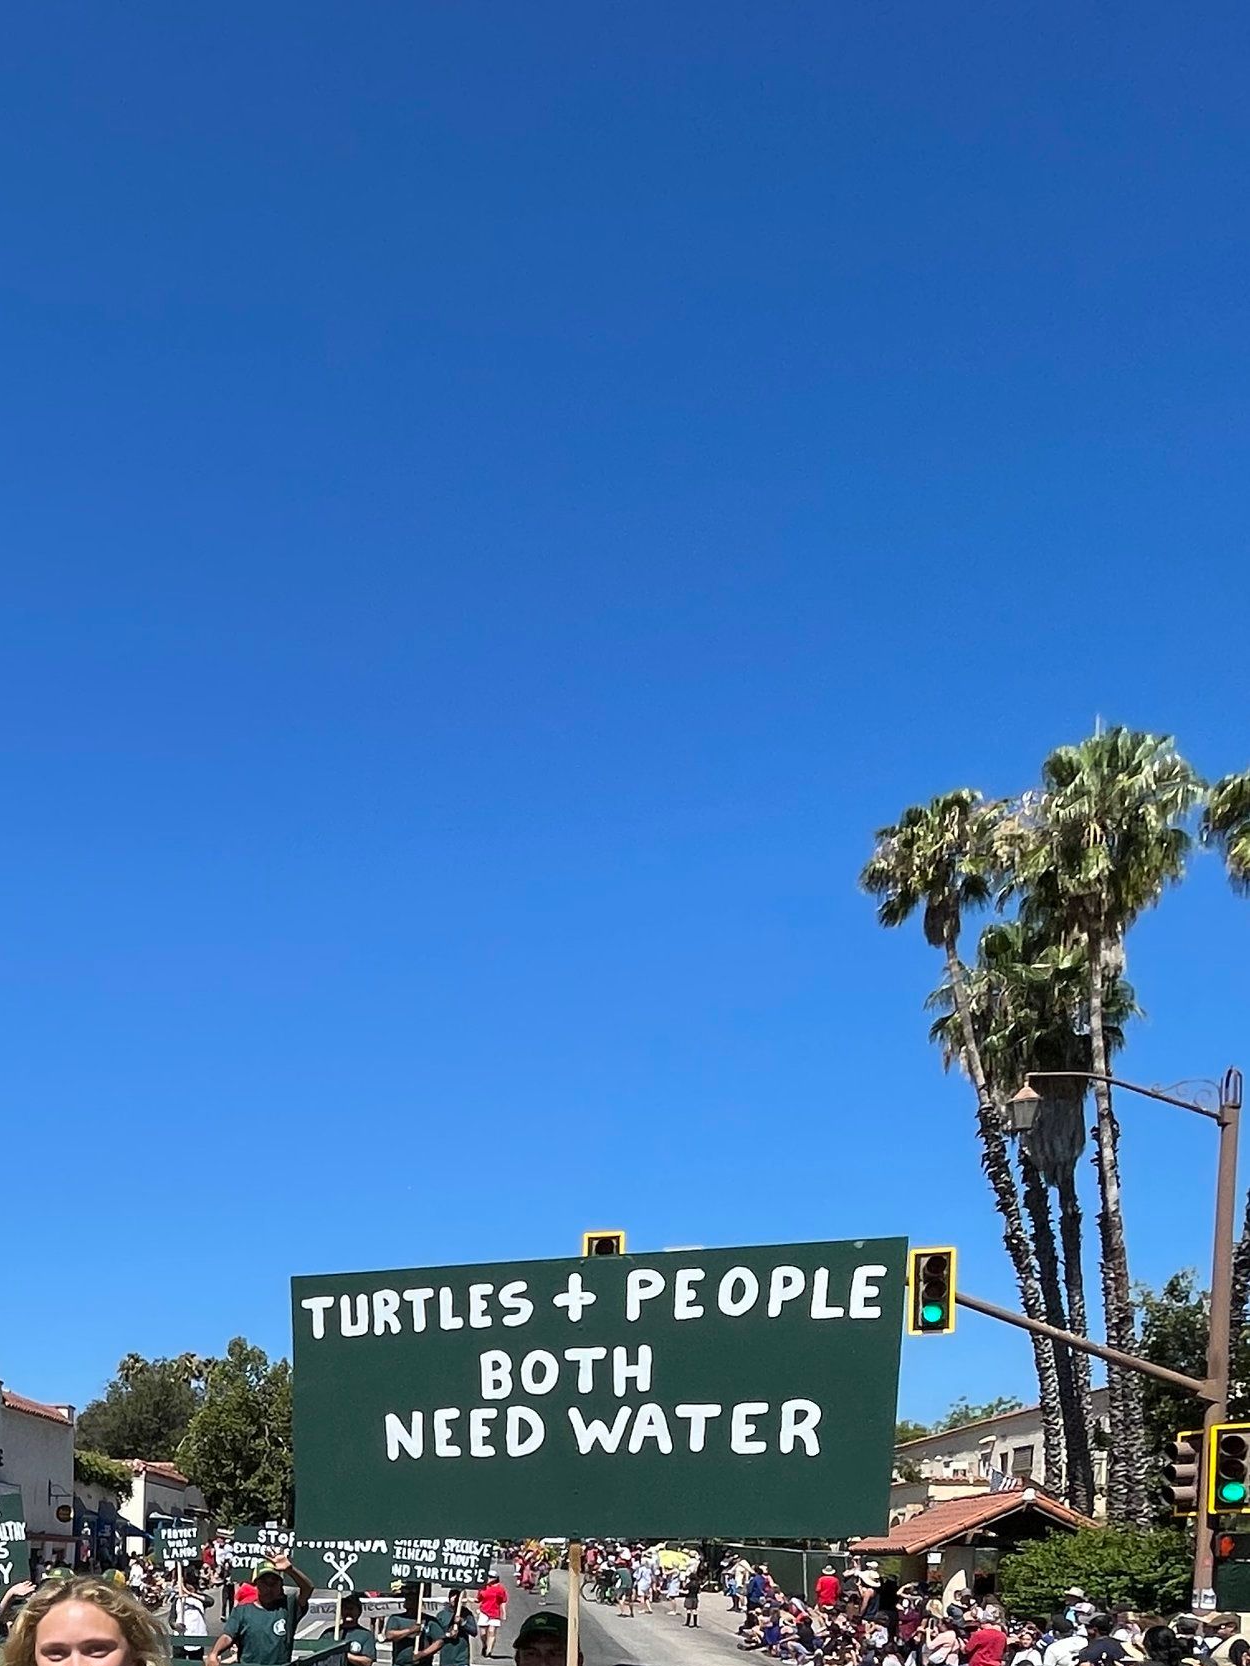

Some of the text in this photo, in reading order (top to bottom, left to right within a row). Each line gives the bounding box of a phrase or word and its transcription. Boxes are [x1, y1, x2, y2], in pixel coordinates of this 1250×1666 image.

[301, 1279, 534, 1339] TURTLES
[625, 1264, 888, 1323] PEOPLE
[480, 1344, 653, 1400] BOTH
[385, 1398, 823, 1461] NEED WATER
[160, 1527, 198, 1539] PROTECT
[162, 1546, 198, 1559] LANDS
[391, 1563, 411, 1578] ND
[413, 1565, 473, 1584] TURTLES
